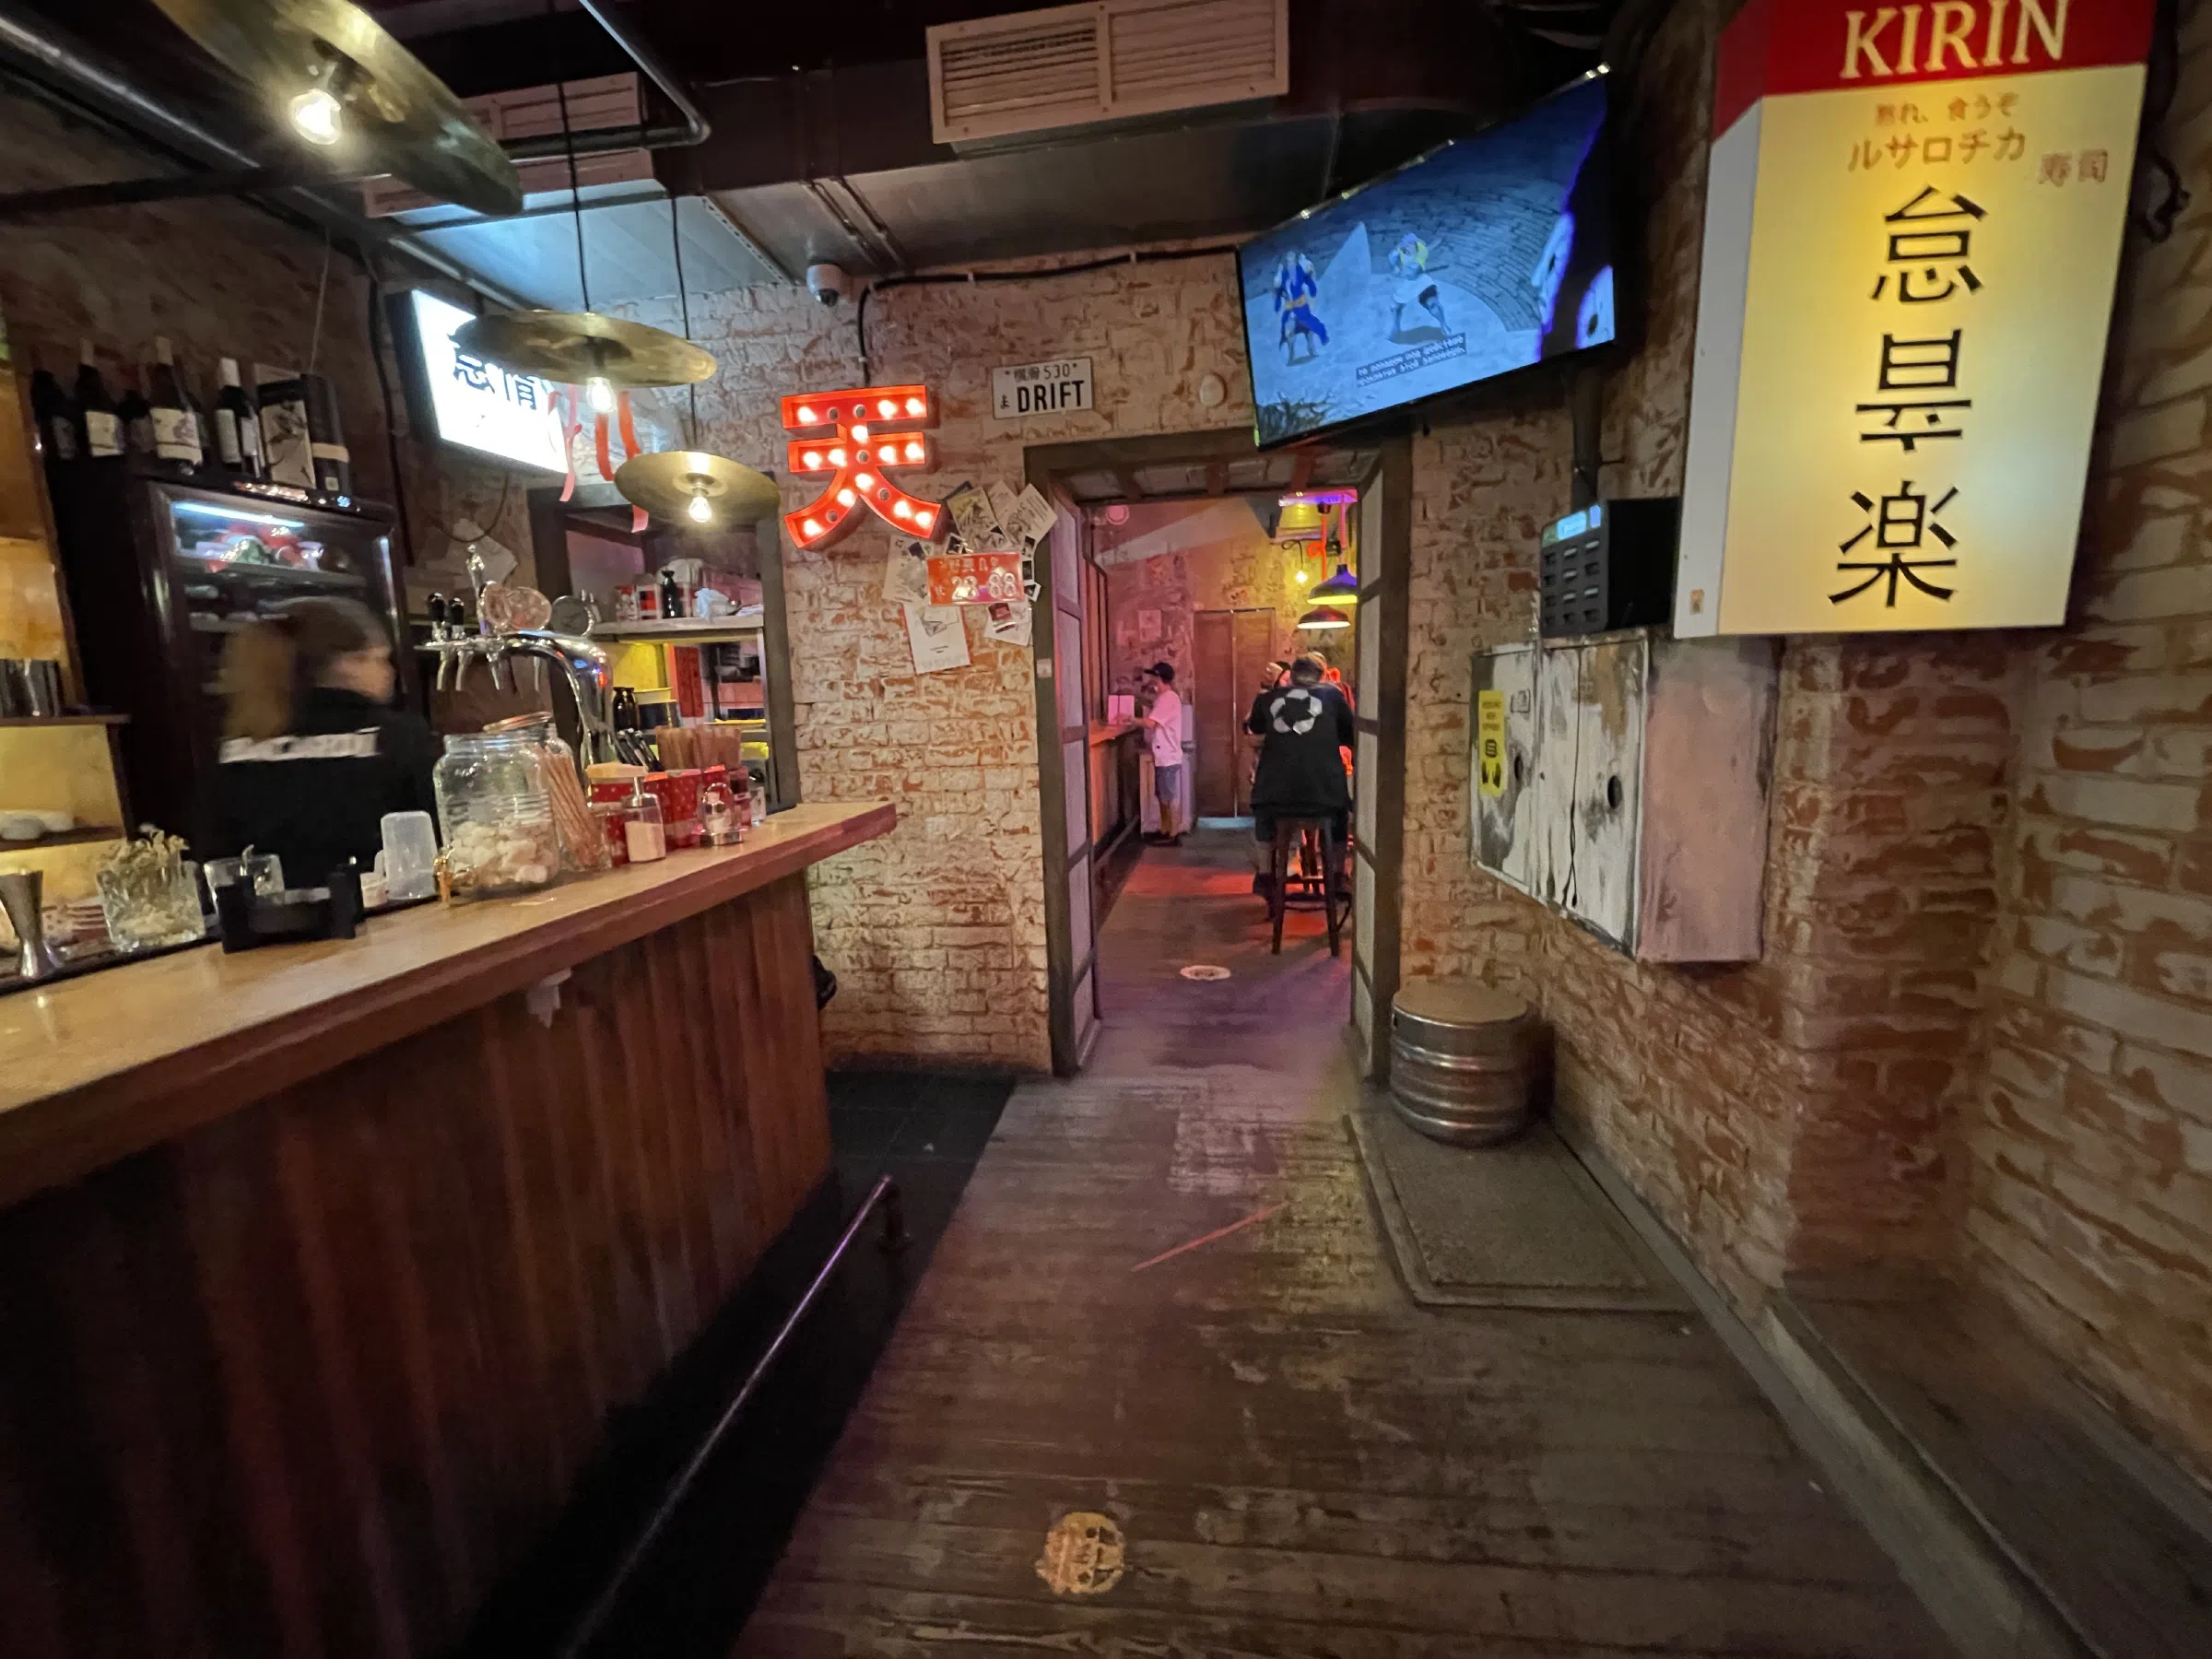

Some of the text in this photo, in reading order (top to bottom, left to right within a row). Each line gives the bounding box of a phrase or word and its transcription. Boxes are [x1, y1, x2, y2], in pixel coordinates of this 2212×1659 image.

[1840, 0, 2069, 79] KIRIN
[1847, 126, 2026, 172] ルサロチカ
[1017, 380, 1085, 413] DRIFT
[782, 385, 942, 549] 天
